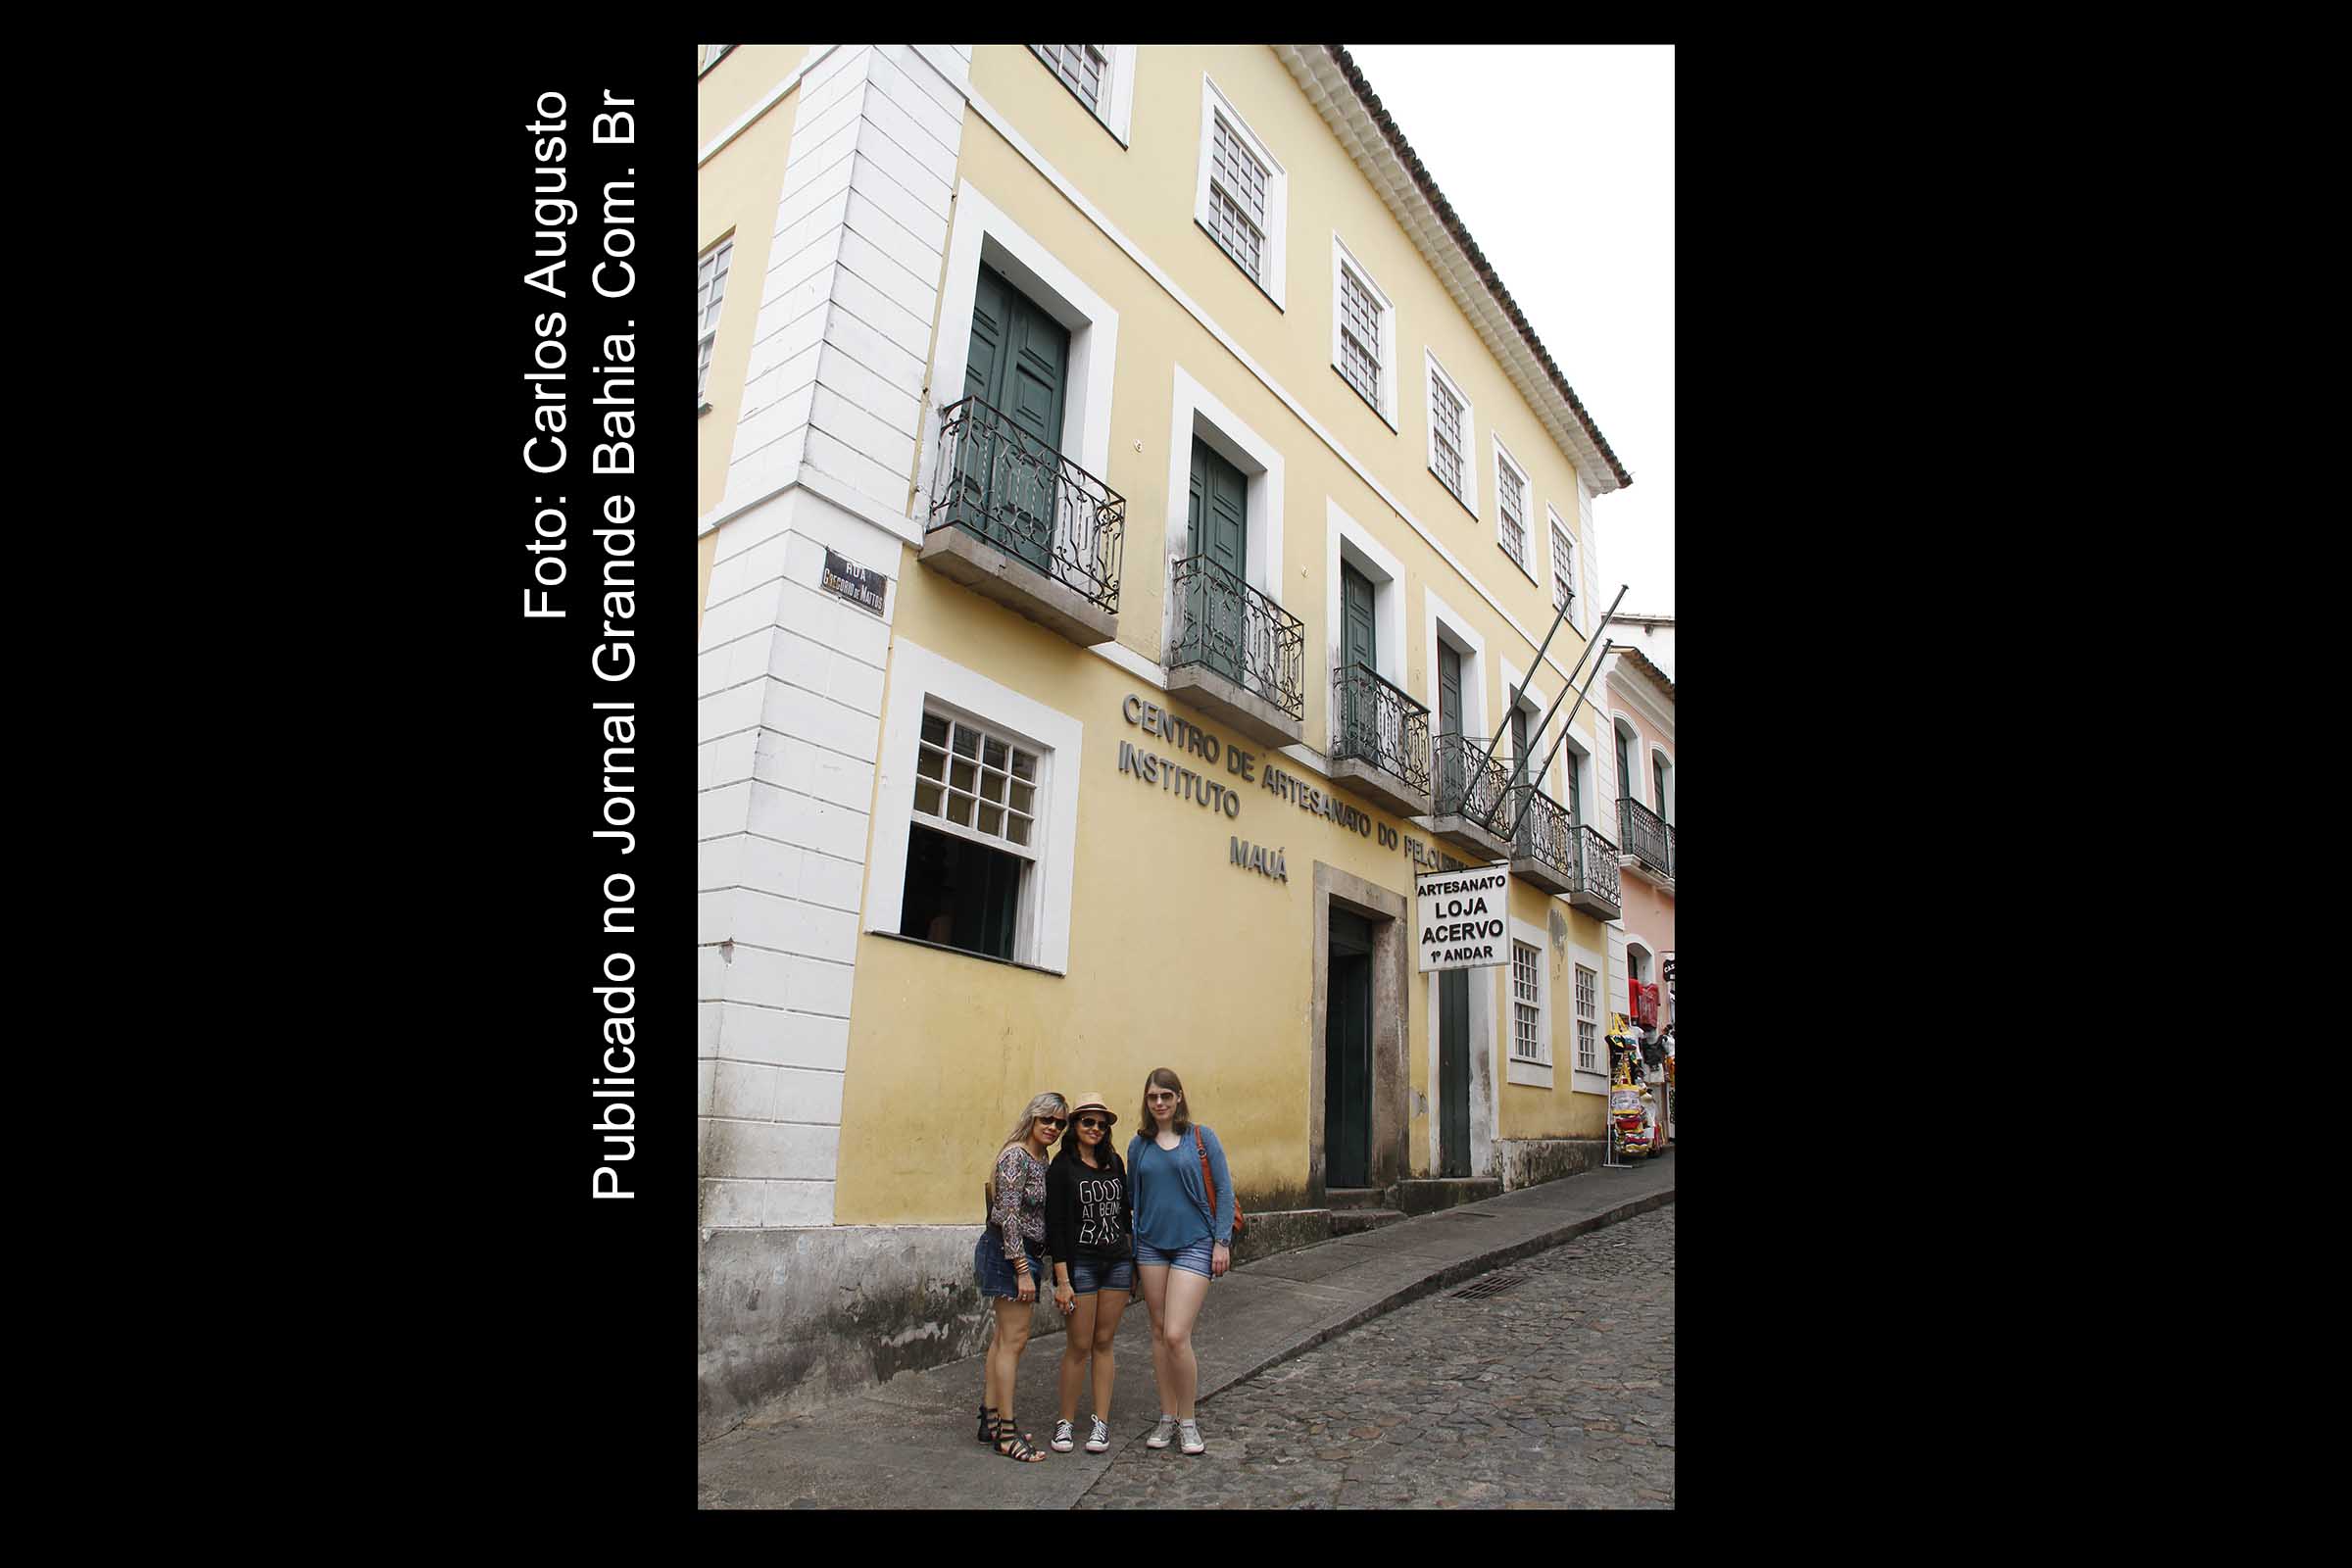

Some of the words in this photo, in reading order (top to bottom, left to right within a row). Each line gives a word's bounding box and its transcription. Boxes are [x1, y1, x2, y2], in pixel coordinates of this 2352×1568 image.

[846, 563, 866, 582] RUA
[1118, 740, 1240, 817] INSTITUTO
[1123, 694, 1220, 764] CENTRO
[1227, 744, 1255, 782] DE
[1262, 764, 1372, 838] ARTESANATO
[1378, 821, 1398, 851] DO
[1230, 836, 1288, 884] MAUÁ
[1417, 875, 1506, 897] ARTESANATO
[1435, 897, 1488, 918] LOJA
[1422, 919, 1504, 944] ACERVO
[1444, 946, 1494, 961] ANDAR
[1079, 1178, 1123, 1203] GOOD
[1082, 1203, 1094, 1218] AT
